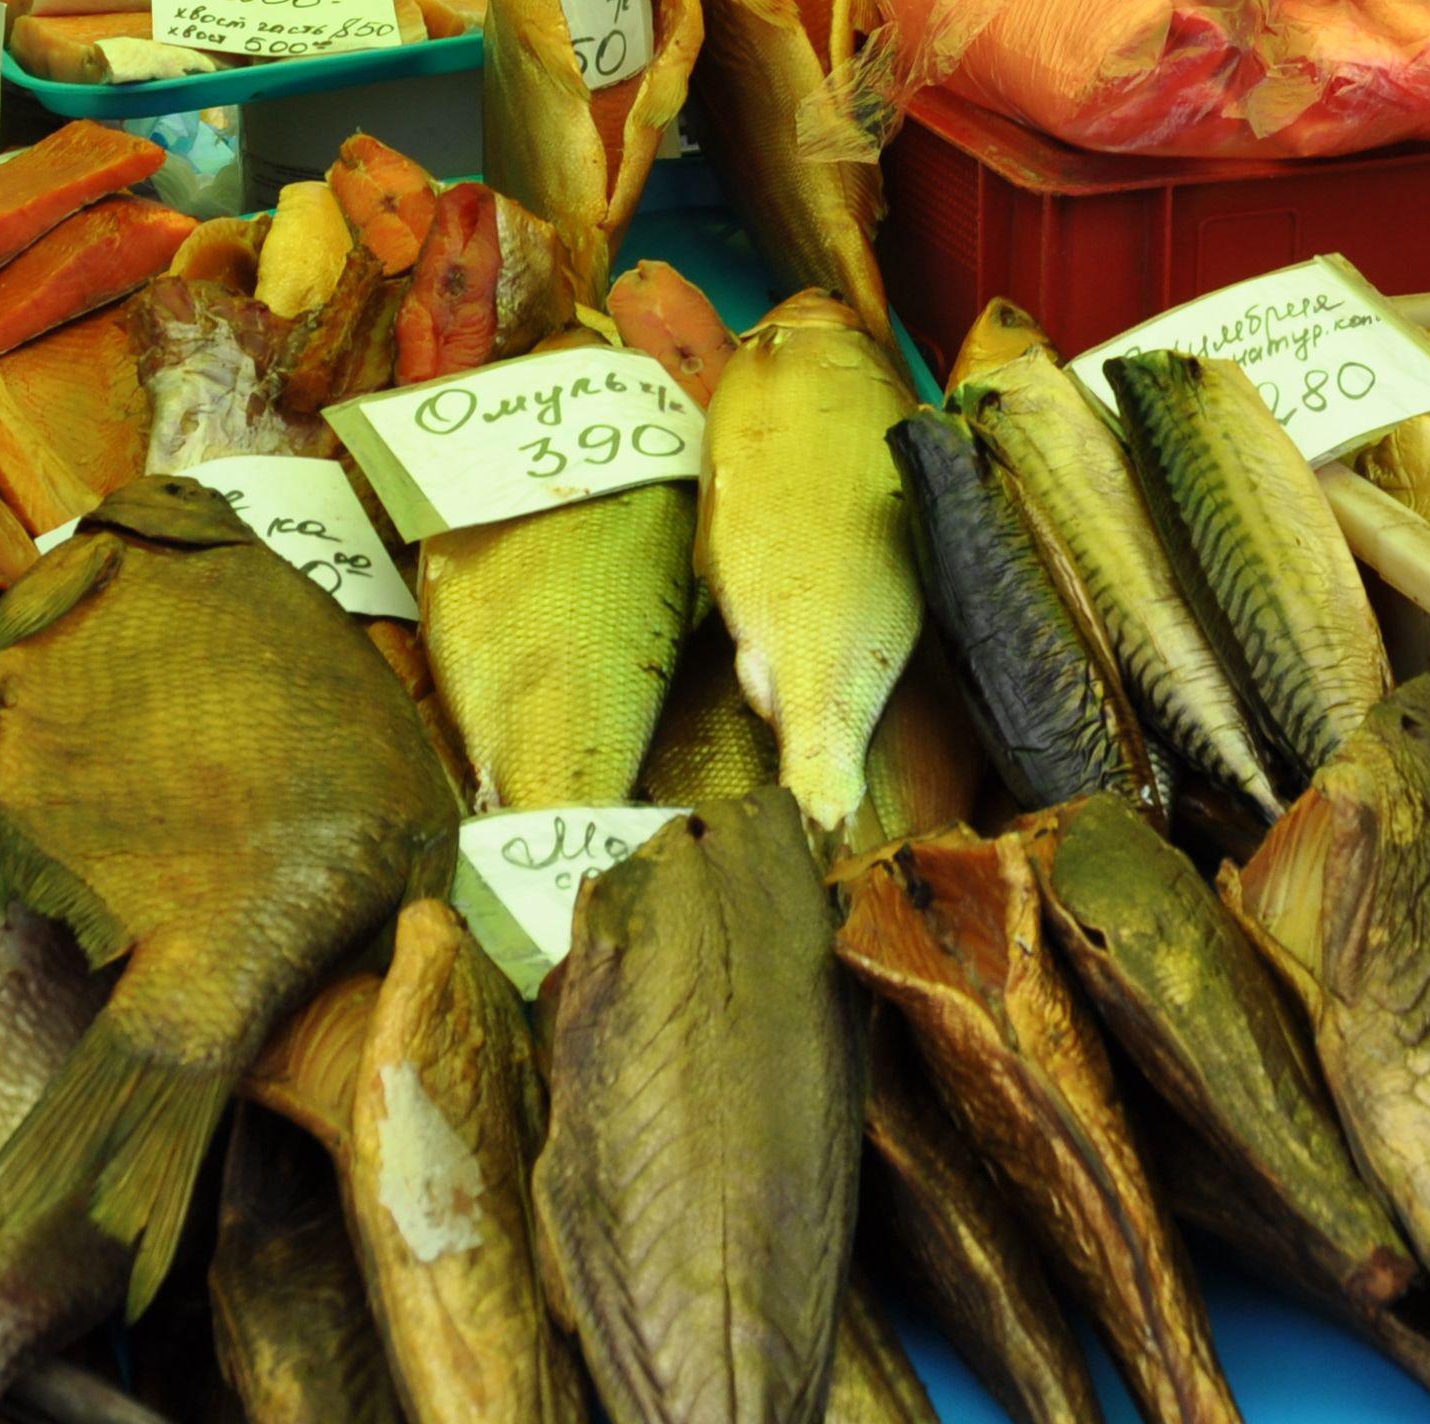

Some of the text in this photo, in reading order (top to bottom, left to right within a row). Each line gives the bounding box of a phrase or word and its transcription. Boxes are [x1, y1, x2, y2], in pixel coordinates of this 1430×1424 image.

[570, 29, 628, 76] 50
[413, 372, 628, 436] Омуль
[518, 422, 687, 479] 390
